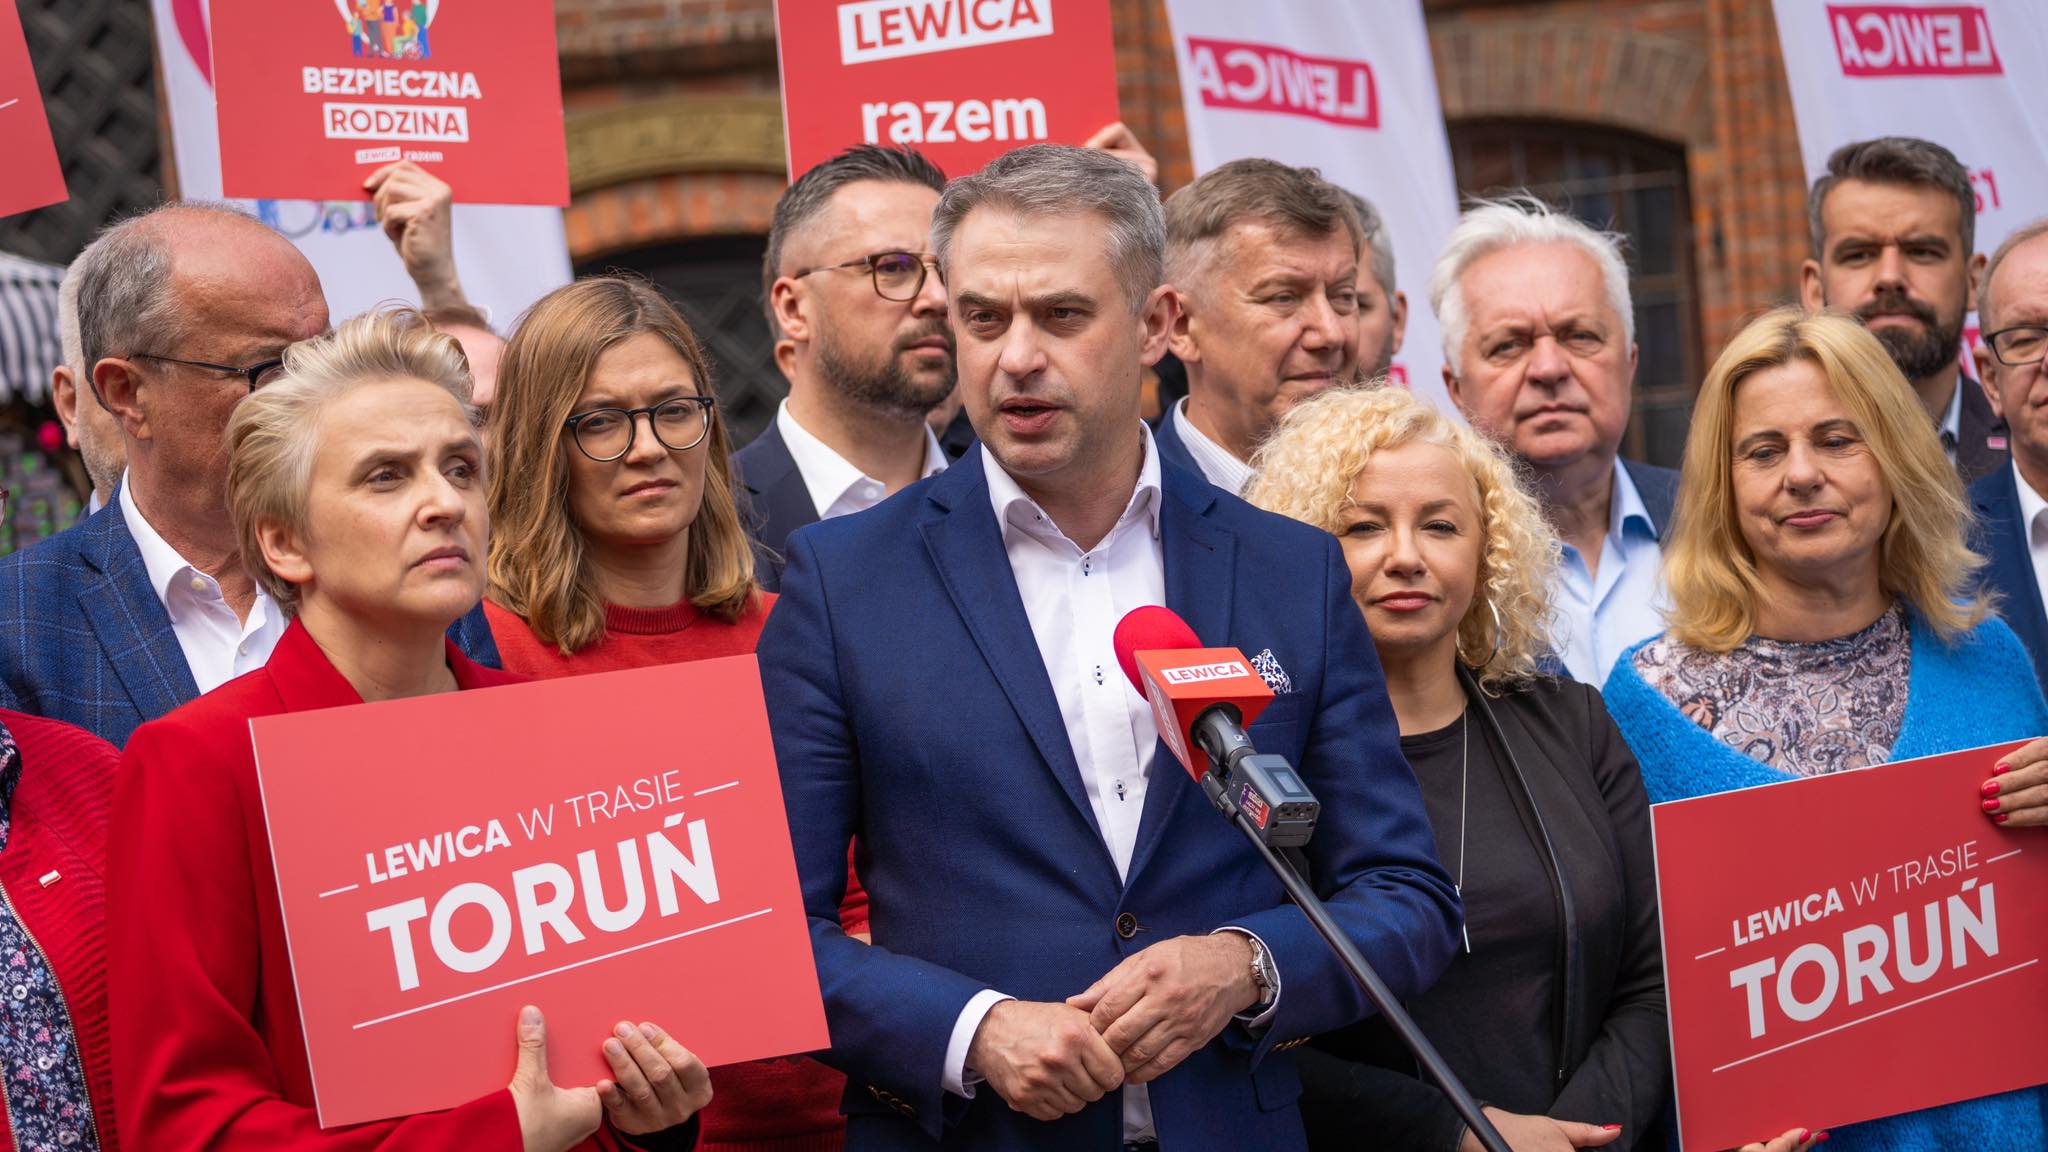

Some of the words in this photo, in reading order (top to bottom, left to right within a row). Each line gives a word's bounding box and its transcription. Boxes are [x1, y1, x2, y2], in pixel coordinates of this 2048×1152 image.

[854, 0, 1041, 51] LEWICA
[302, 66, 482, 99] BEZPIECZNA
[331, 108, 463, 136] RODZINA
[861, 97, 1048, 145] razem
[1168, 664, 1244, 681] LEWICA
[366, 818, 512, 884] LEWICA
[517, 803, 554, 841] W
[564, 770, 685, 828] TRASIE
[366, 812, 721, 992] TORUŃ
[1733, 887, 1845, 947] LEWICA
[1850, 873, 1879, 906] W
[1887, 840, 1980, 894] TRASIE
[1729, 877, 2000, 1040] TORUŃ
